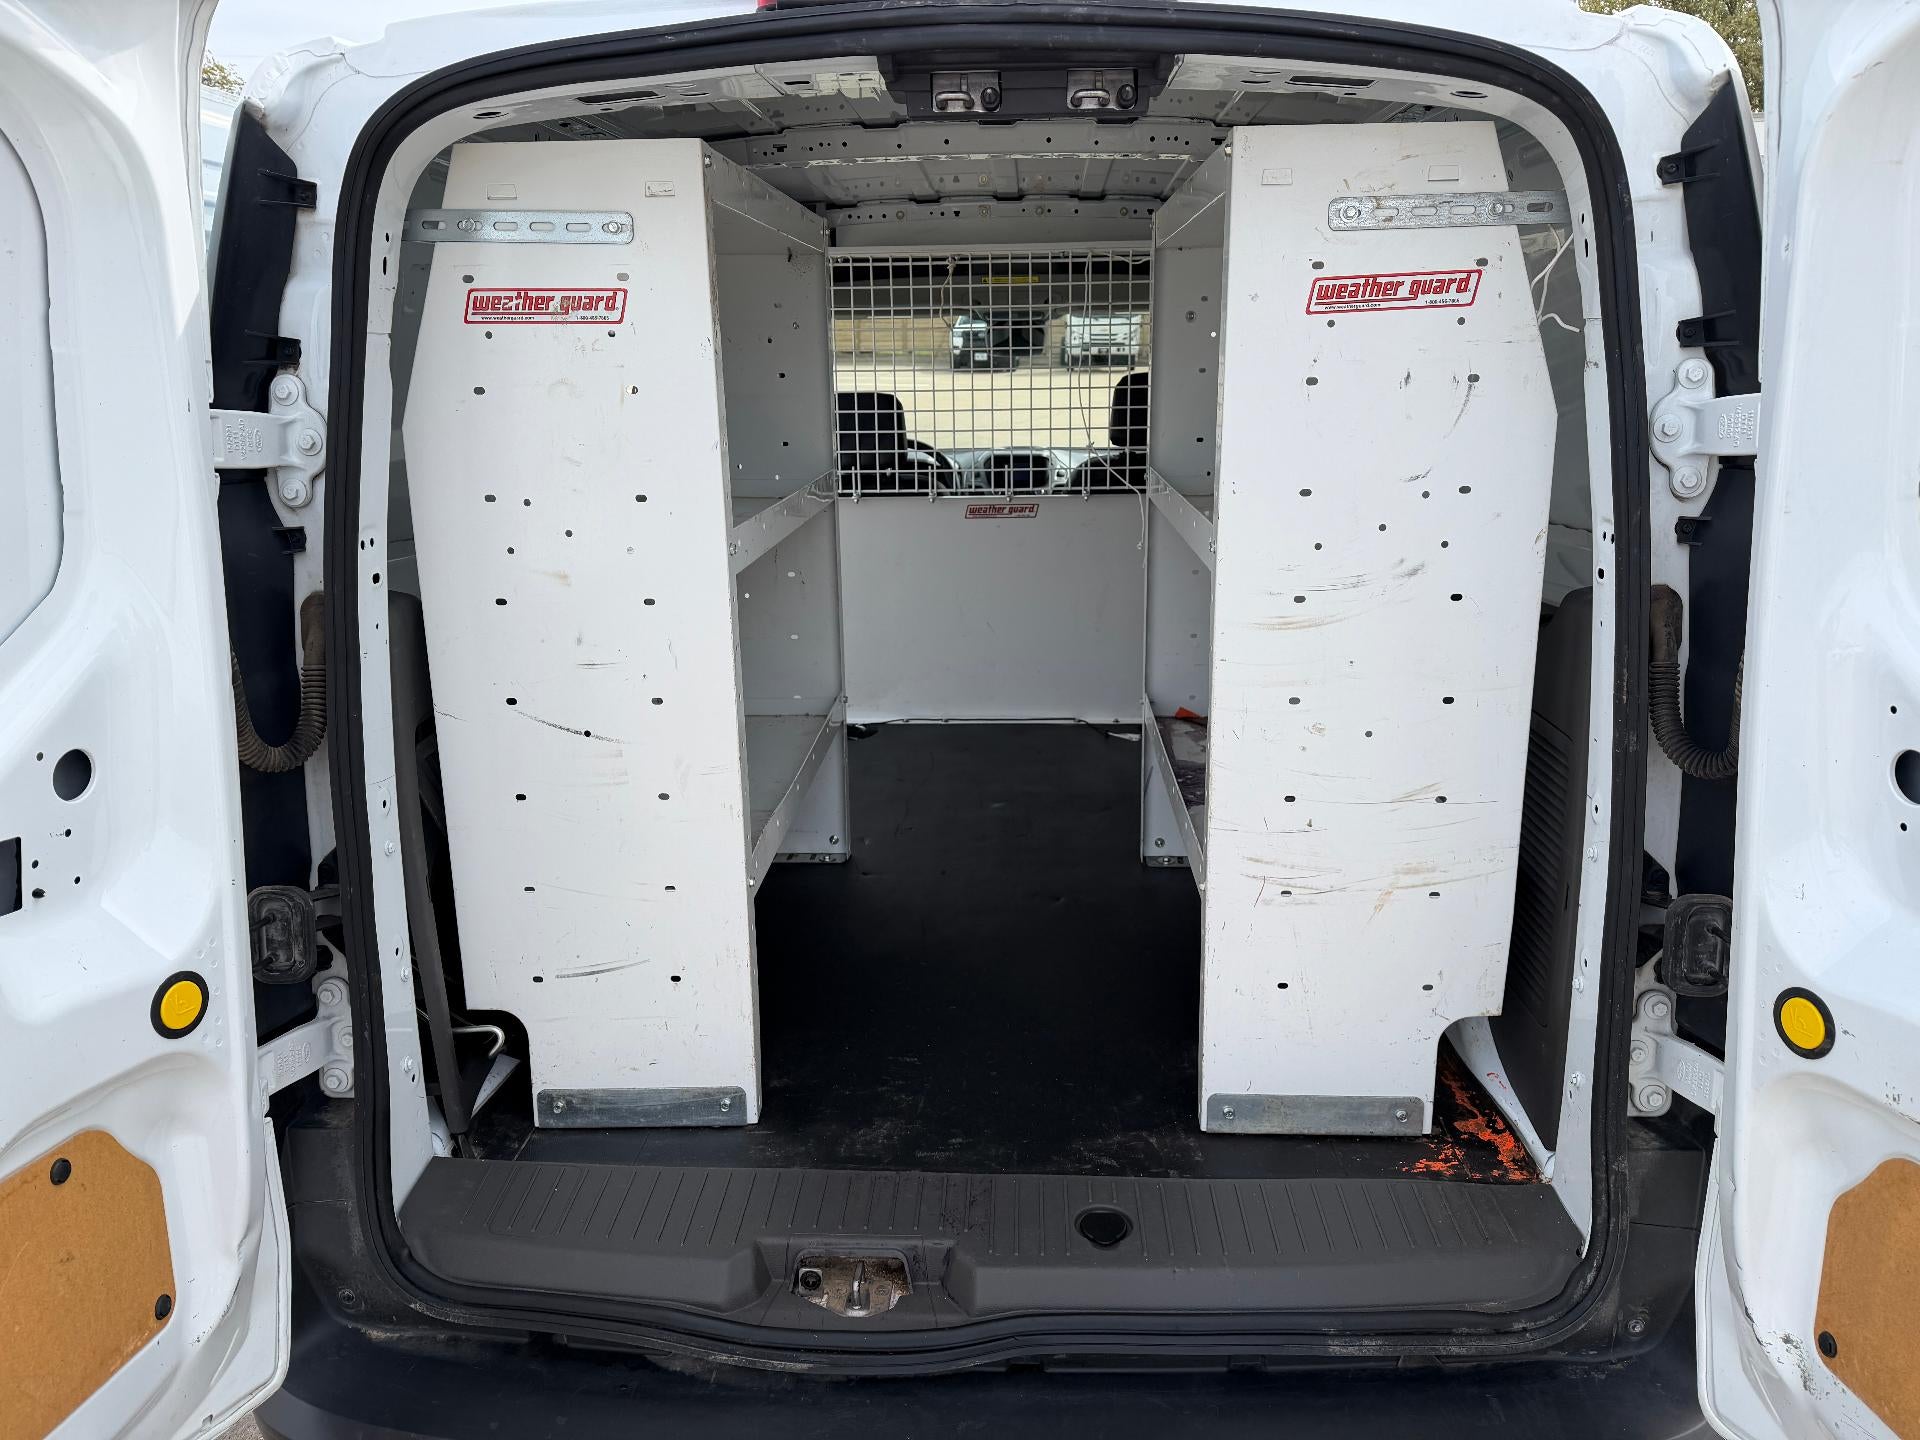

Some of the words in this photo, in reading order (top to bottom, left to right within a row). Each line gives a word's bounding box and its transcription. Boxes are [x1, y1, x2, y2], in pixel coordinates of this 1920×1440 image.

[1316, 278, 1405, 300] weather
[1409, 273, 1471, 300] guard
[559, 292, 617, 315] guard
[969, 505, 1006, 513] weather
[1009, 505, 1035, 515] guard
